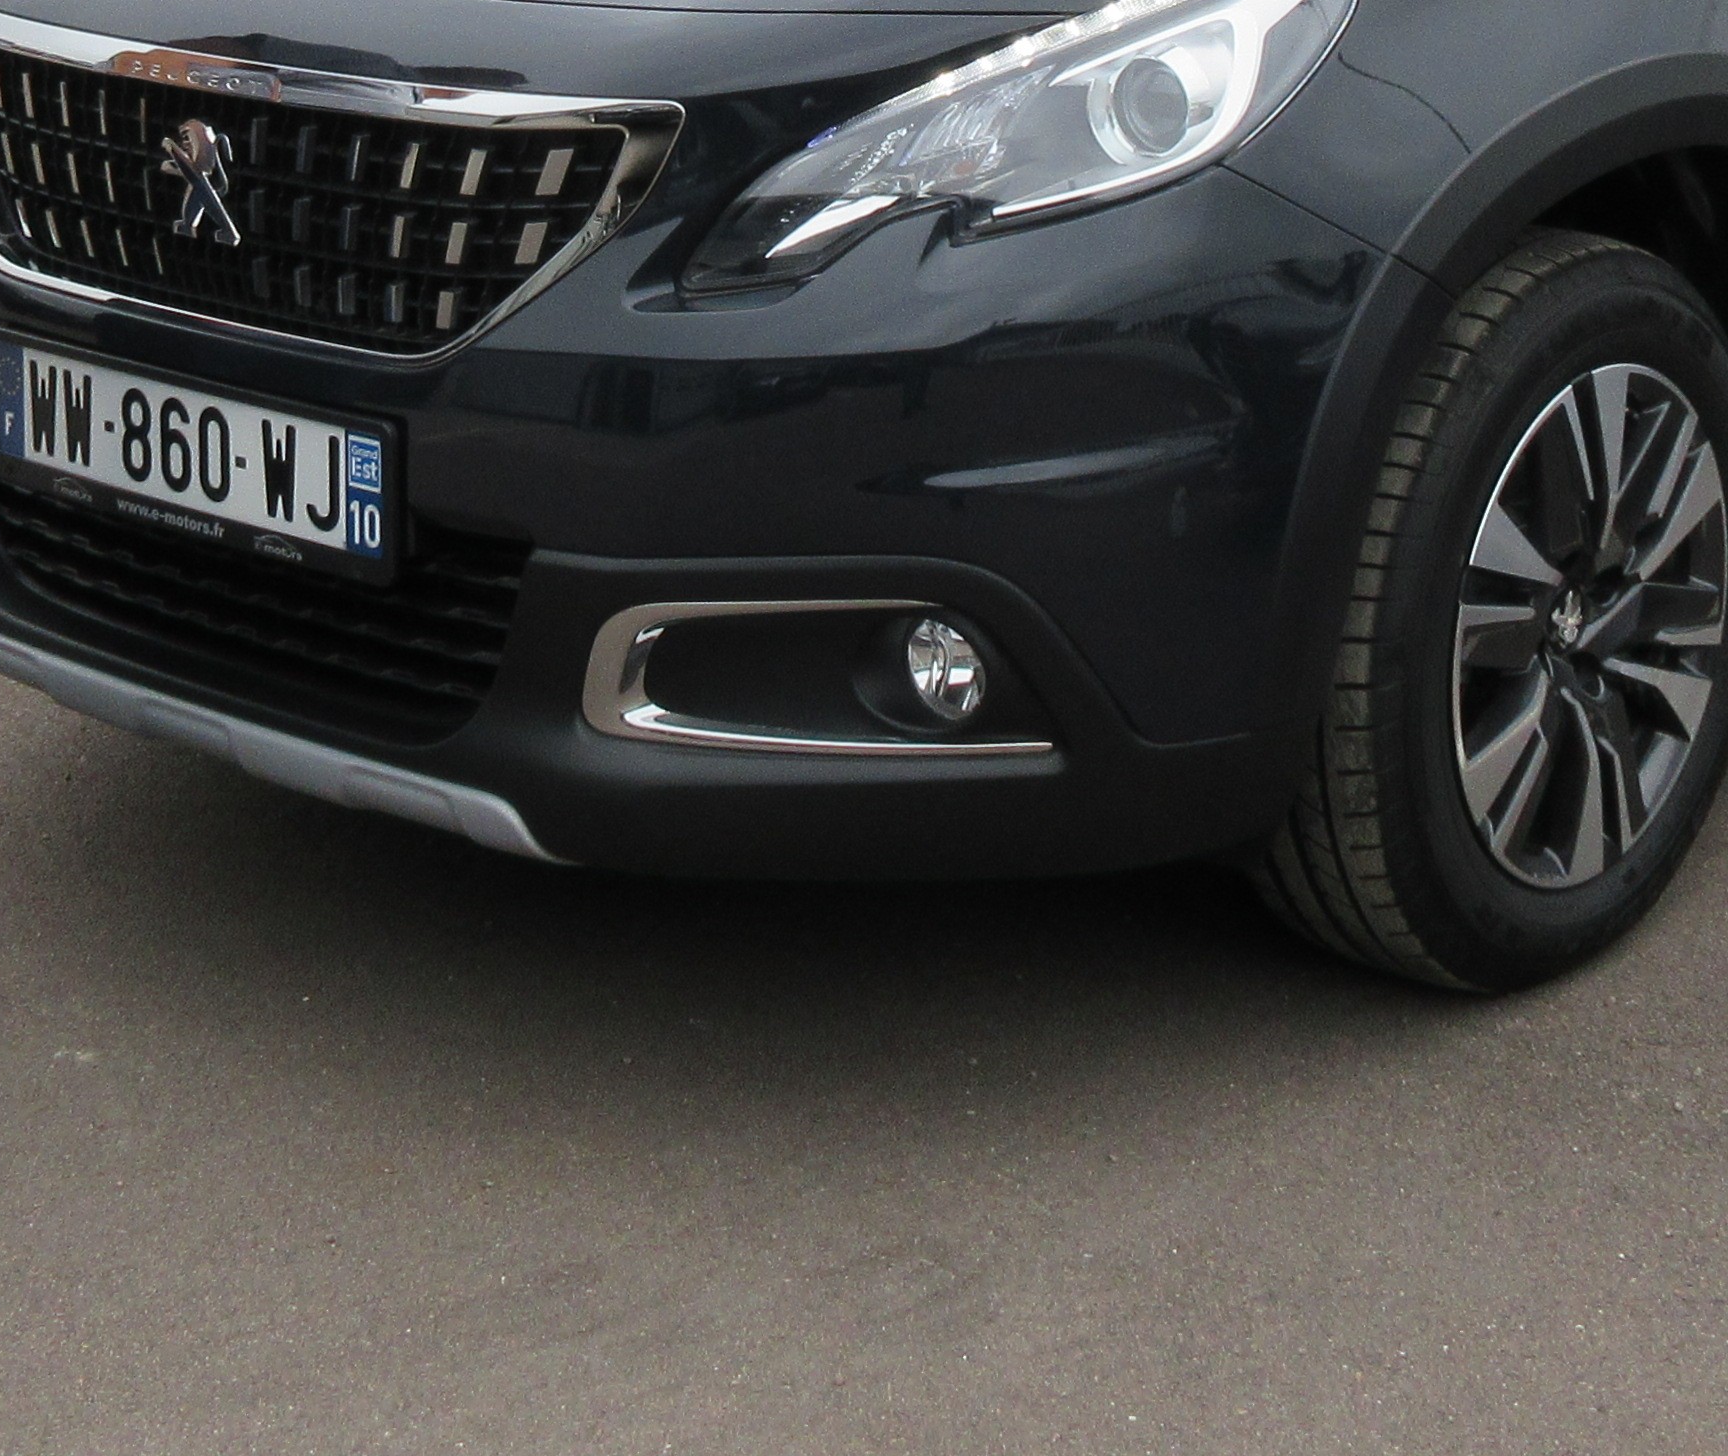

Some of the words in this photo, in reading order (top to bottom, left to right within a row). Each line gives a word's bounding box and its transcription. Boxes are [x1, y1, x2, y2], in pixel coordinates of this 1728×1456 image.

[132, 59, 265, 95] PEUGEOT
[4, 410, 15, 436] F
[29, 359, 341, 532] WW-860-WJ
[350, 445, 379, 460] Grand
[351, 457, 379, 482] Est
[116, 499, 225, 539] www.e-motors.fr
[349, 499, 381, 549] 10
